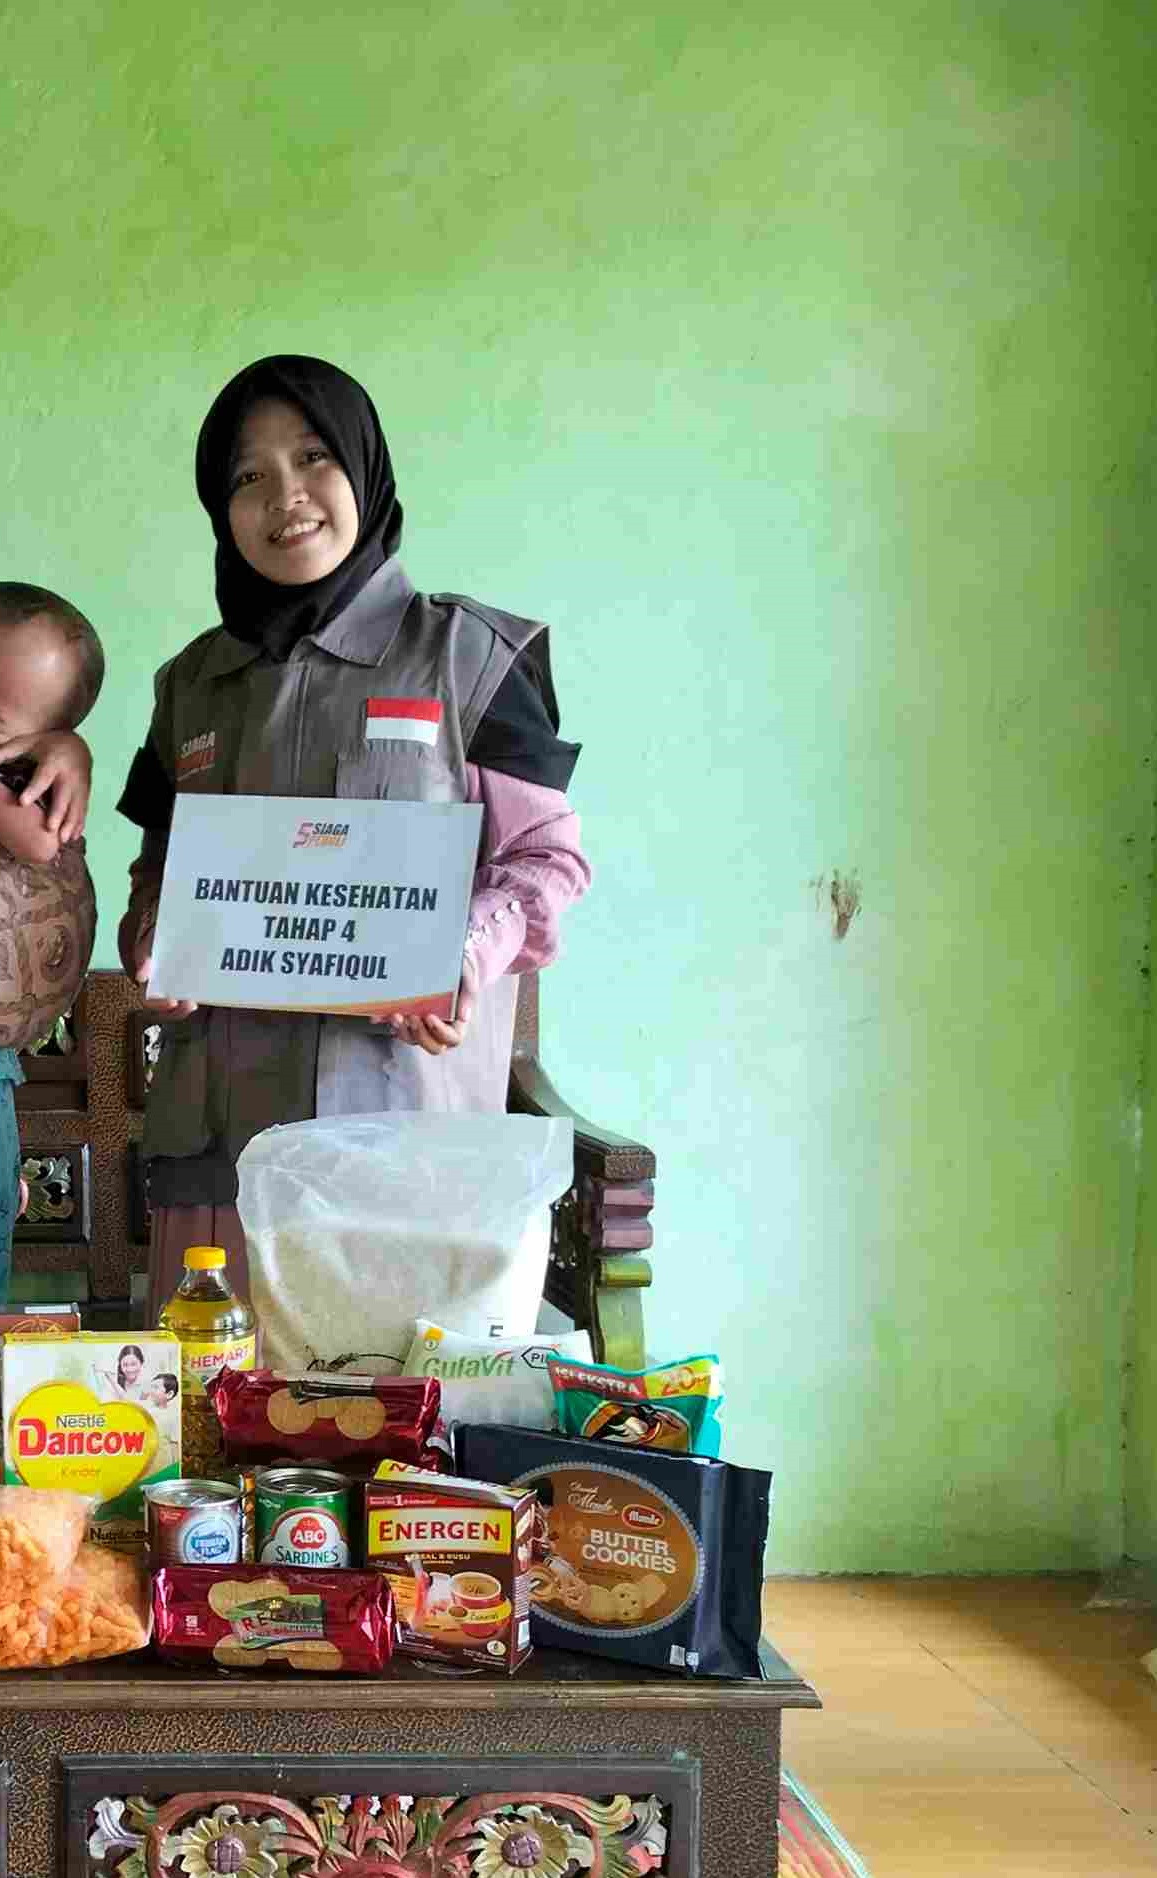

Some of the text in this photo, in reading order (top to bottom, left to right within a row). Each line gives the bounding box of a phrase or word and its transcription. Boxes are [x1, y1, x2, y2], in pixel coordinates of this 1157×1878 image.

[312, 822, 351, 835] SIAGA
[194, 877, 439, 912] BANTUAN KESEHATAN
[263, 915, 357, 942] TAHAP 4
[220, 947, 389, 981] ADIK SYAFIQUL
[423, 1354, 514, 1377] GulaVit
[531, 1352, 547, 1363] PI
[577, 1373, 640, 1393] EKSTRA
[19, 1418, 145, 1456] Dancow
[293, 1530, 326, 1544] ABC
[378, 1519, 501, 1542] ENERGEN
[590, 1528, 669, 1556] BUTTER
[275, 1545, 339, 1564] SARDINES
[582, 1543, 677, 1574] COOKIES
